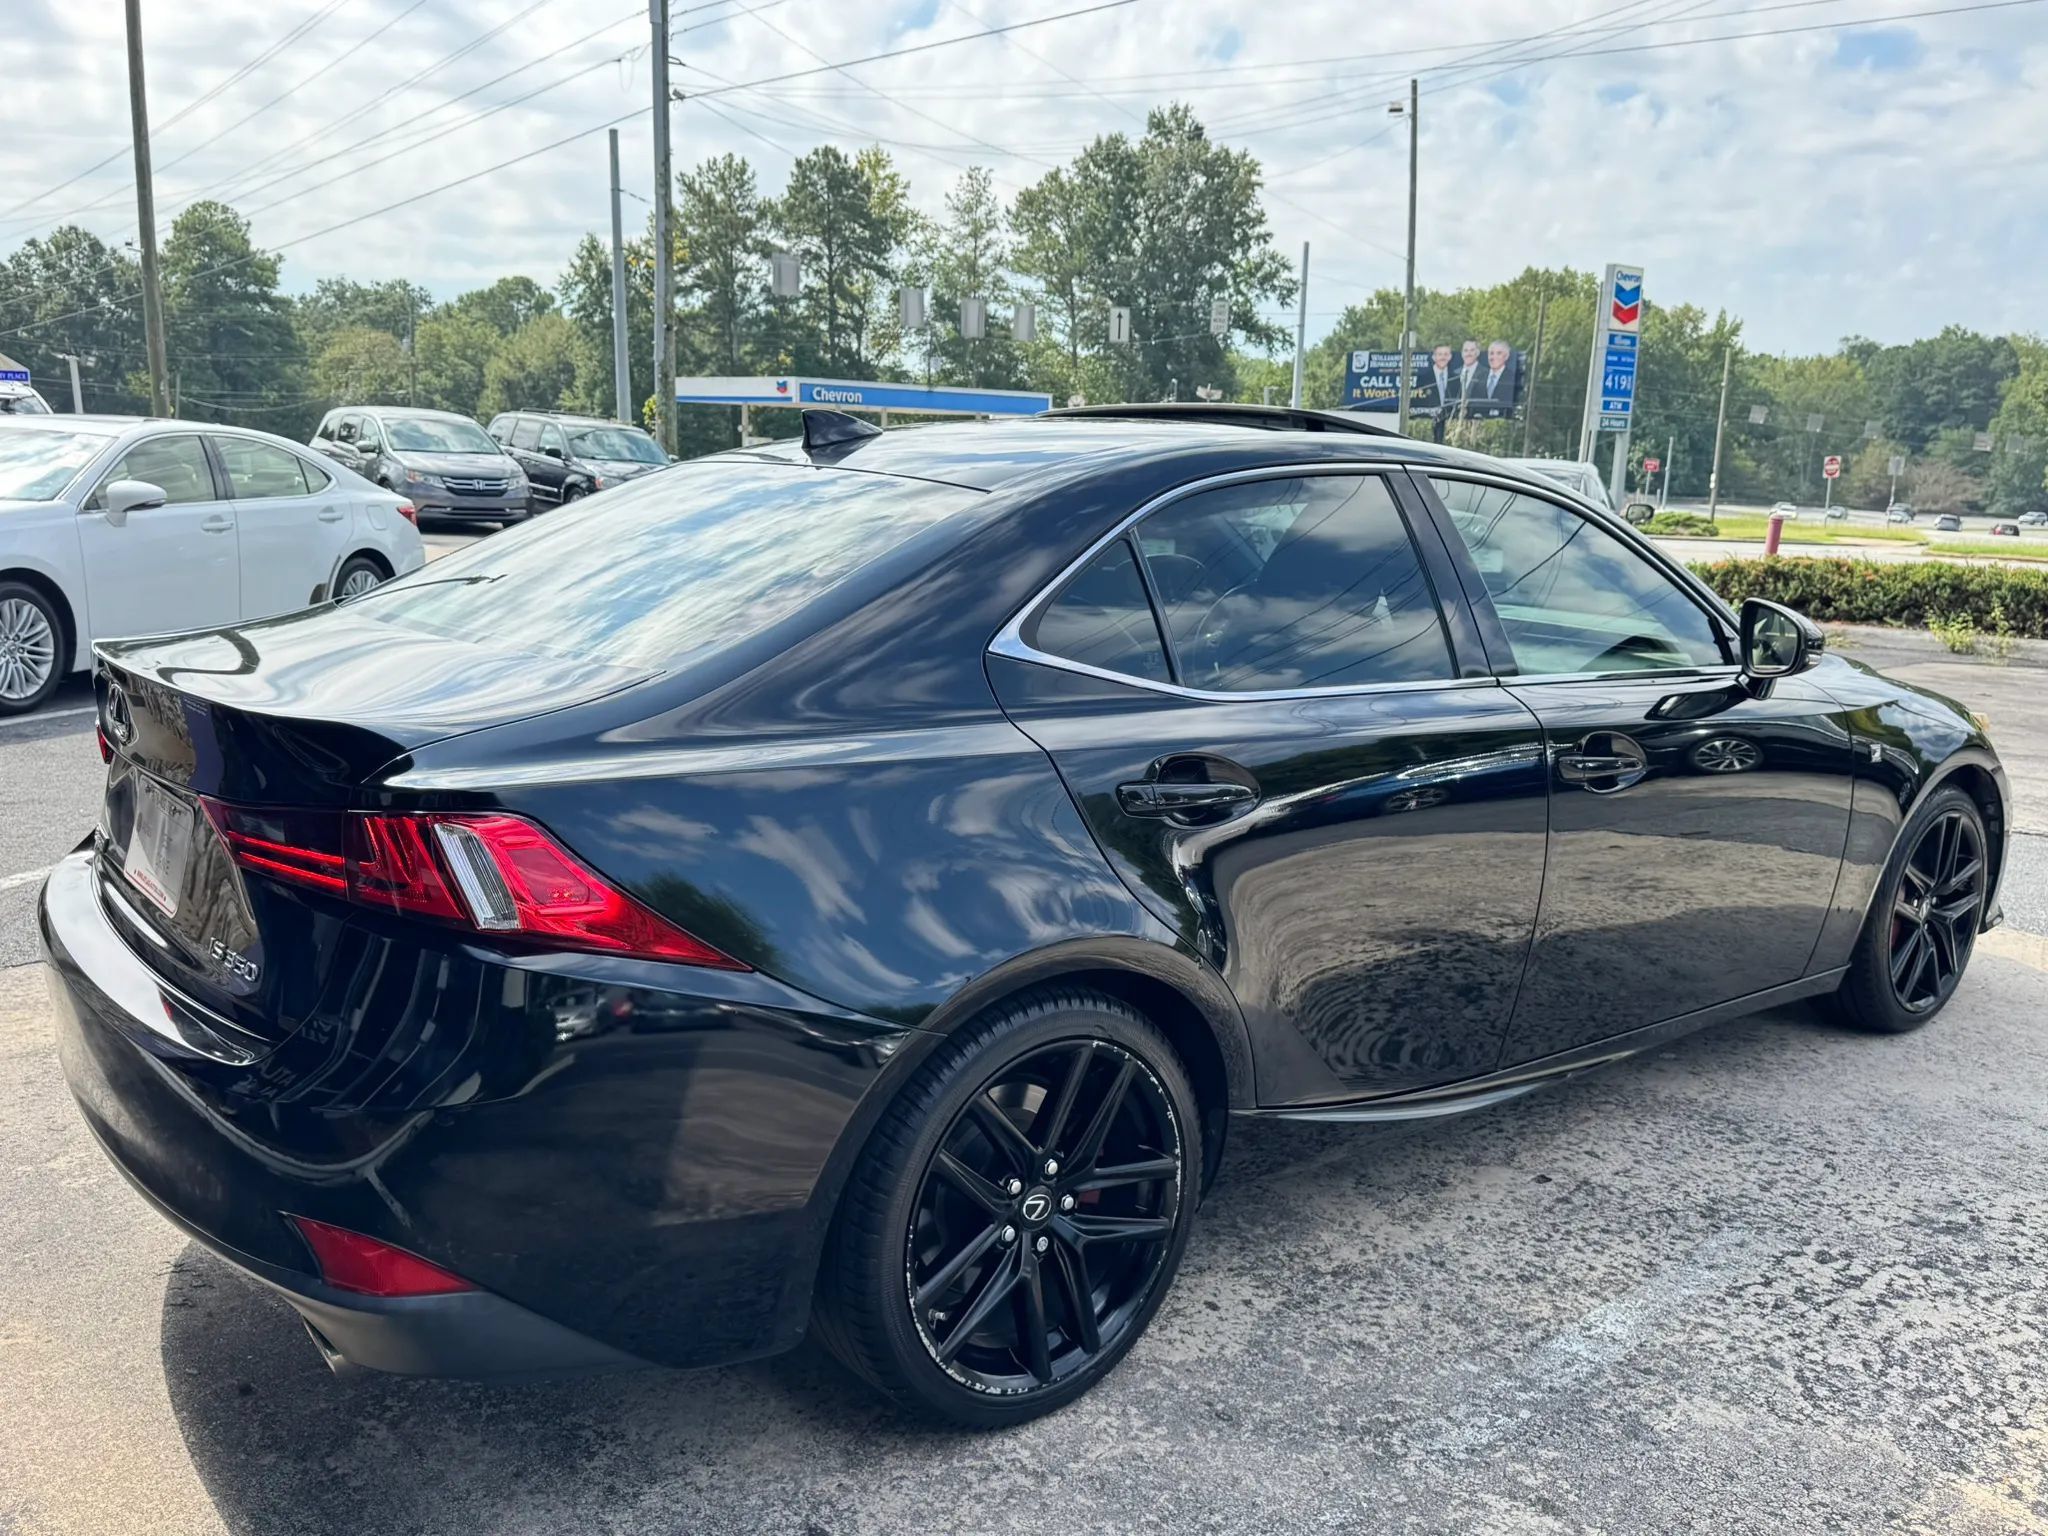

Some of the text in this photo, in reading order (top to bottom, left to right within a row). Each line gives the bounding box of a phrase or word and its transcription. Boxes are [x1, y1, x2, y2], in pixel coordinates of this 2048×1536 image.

[1360, 376, 1393, 388] CALL
[812, 386, 862, 404] Chevron
[1352, 388, 1361, 398] It
[1363, 388, 1396, 398] Won't
